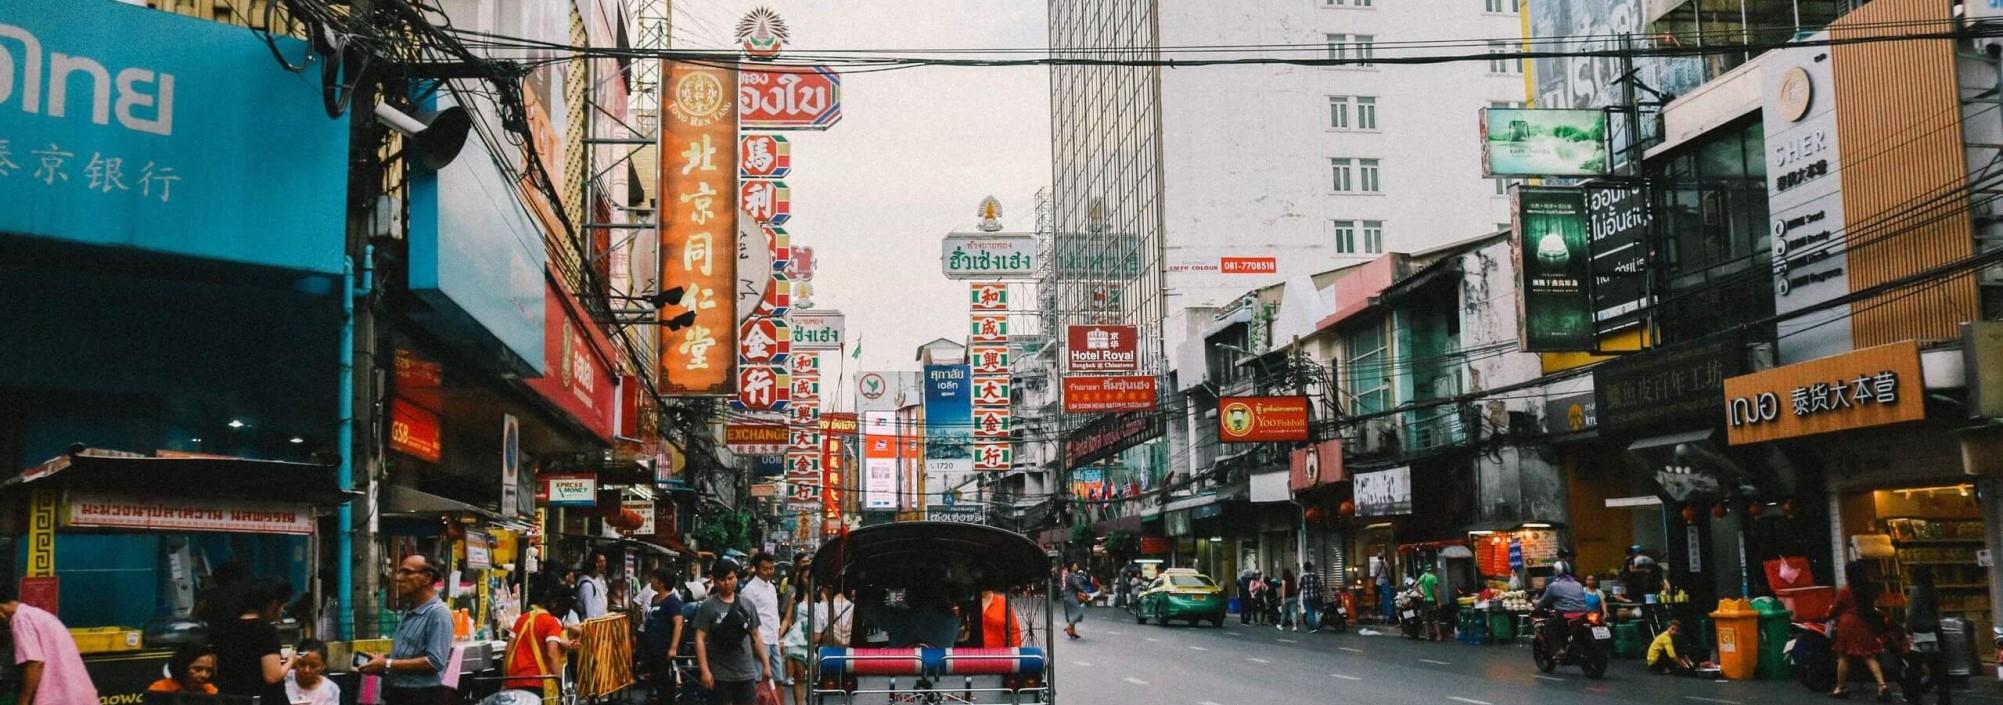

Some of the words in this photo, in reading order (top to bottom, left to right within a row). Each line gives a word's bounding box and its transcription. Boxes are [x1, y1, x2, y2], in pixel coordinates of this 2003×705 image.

[0, 23, 175, 136] ไทย
[668, 101, 688, 123] TONG
[690, 115, 712, 127] REN
[710, 100, 733, 122] TANG
[1776, 130, 1828, 168] SHER
[679, 133, 718, 370] 北京同仁堂
[744, 137, 776, 405] 馬利金行
[1224, 261, 1275, 270] 081-7708518
[1071, 350, 1100, 361] Hotel
[1102, 350, 1134, 362] Royal
[1791, 371, 1897, 416] 泰货大本营
[391, 420, 409, 444] GSB
[727, 428, 789, 441] EXCHANGE
[1277, 418, 1305, 427] Fishball
[762, 456, 782, 464] UOB
[936, 462, 954, 470] 1720
